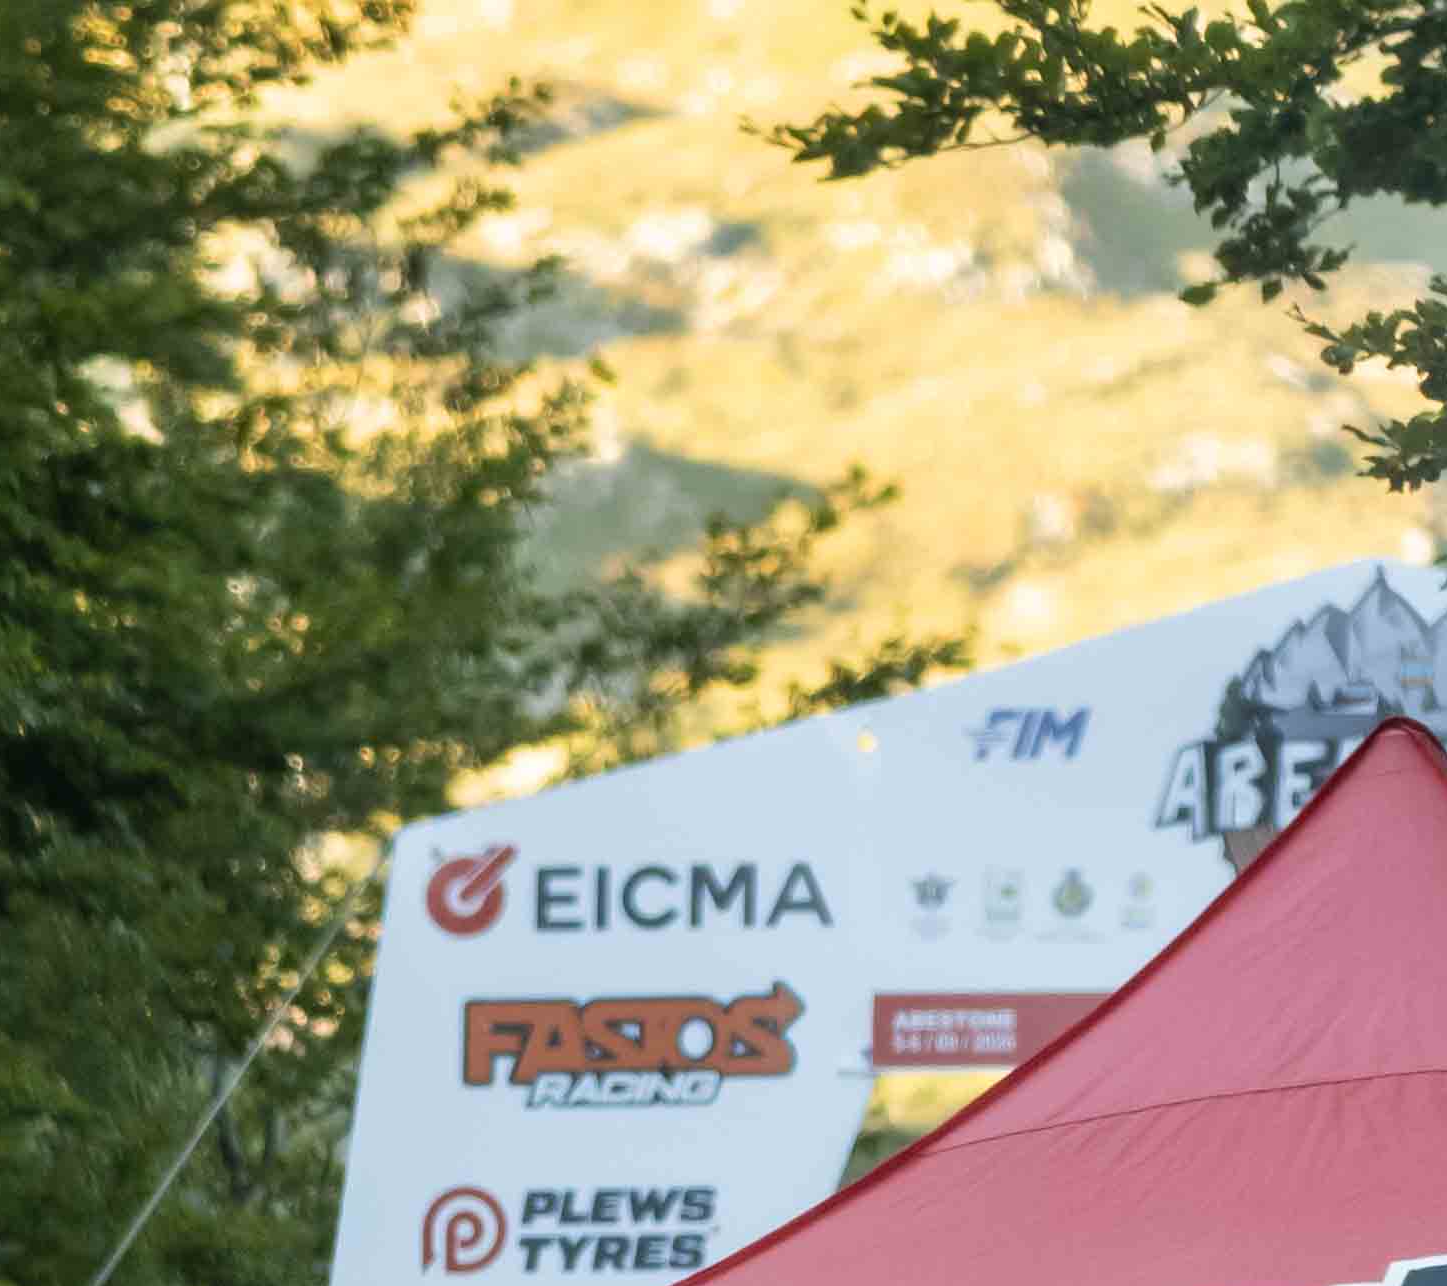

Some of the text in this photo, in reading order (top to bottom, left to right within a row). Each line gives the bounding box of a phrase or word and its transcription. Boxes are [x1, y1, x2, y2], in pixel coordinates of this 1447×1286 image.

[967, 707, 1092, 761] FIM
[534, 863, 834, 932] EICMA
[526, 1070, 722, 1109] RACING
[521, 1186, 716, 1226] PLEWS
[519, 1233, 709, 1274] TYRES
